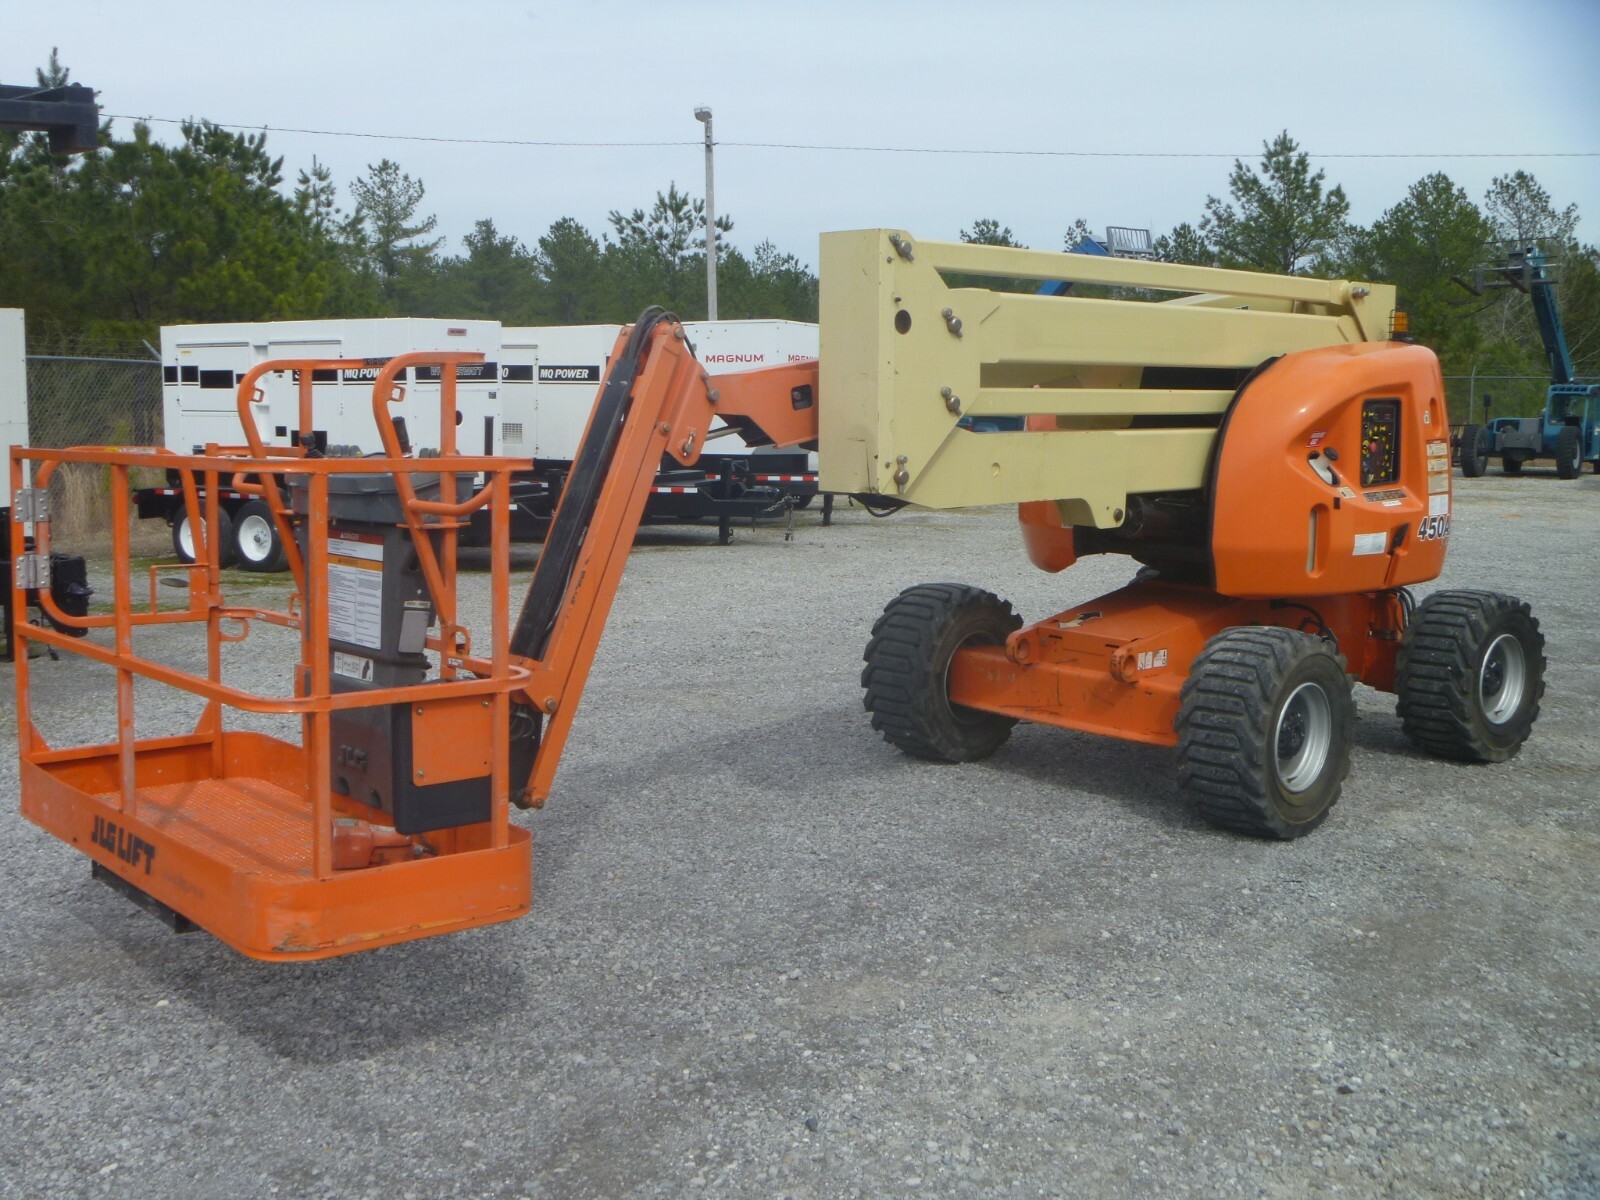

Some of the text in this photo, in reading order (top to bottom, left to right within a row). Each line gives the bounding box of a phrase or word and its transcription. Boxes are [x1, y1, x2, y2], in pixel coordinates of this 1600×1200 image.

[705, 354, 764, 363] MAGNUM
[344, 369, 382, 379] MQ POW
[540, 368, 589, 379] MQ POWER
[91, 815, 156, 876] JLG LIFT
